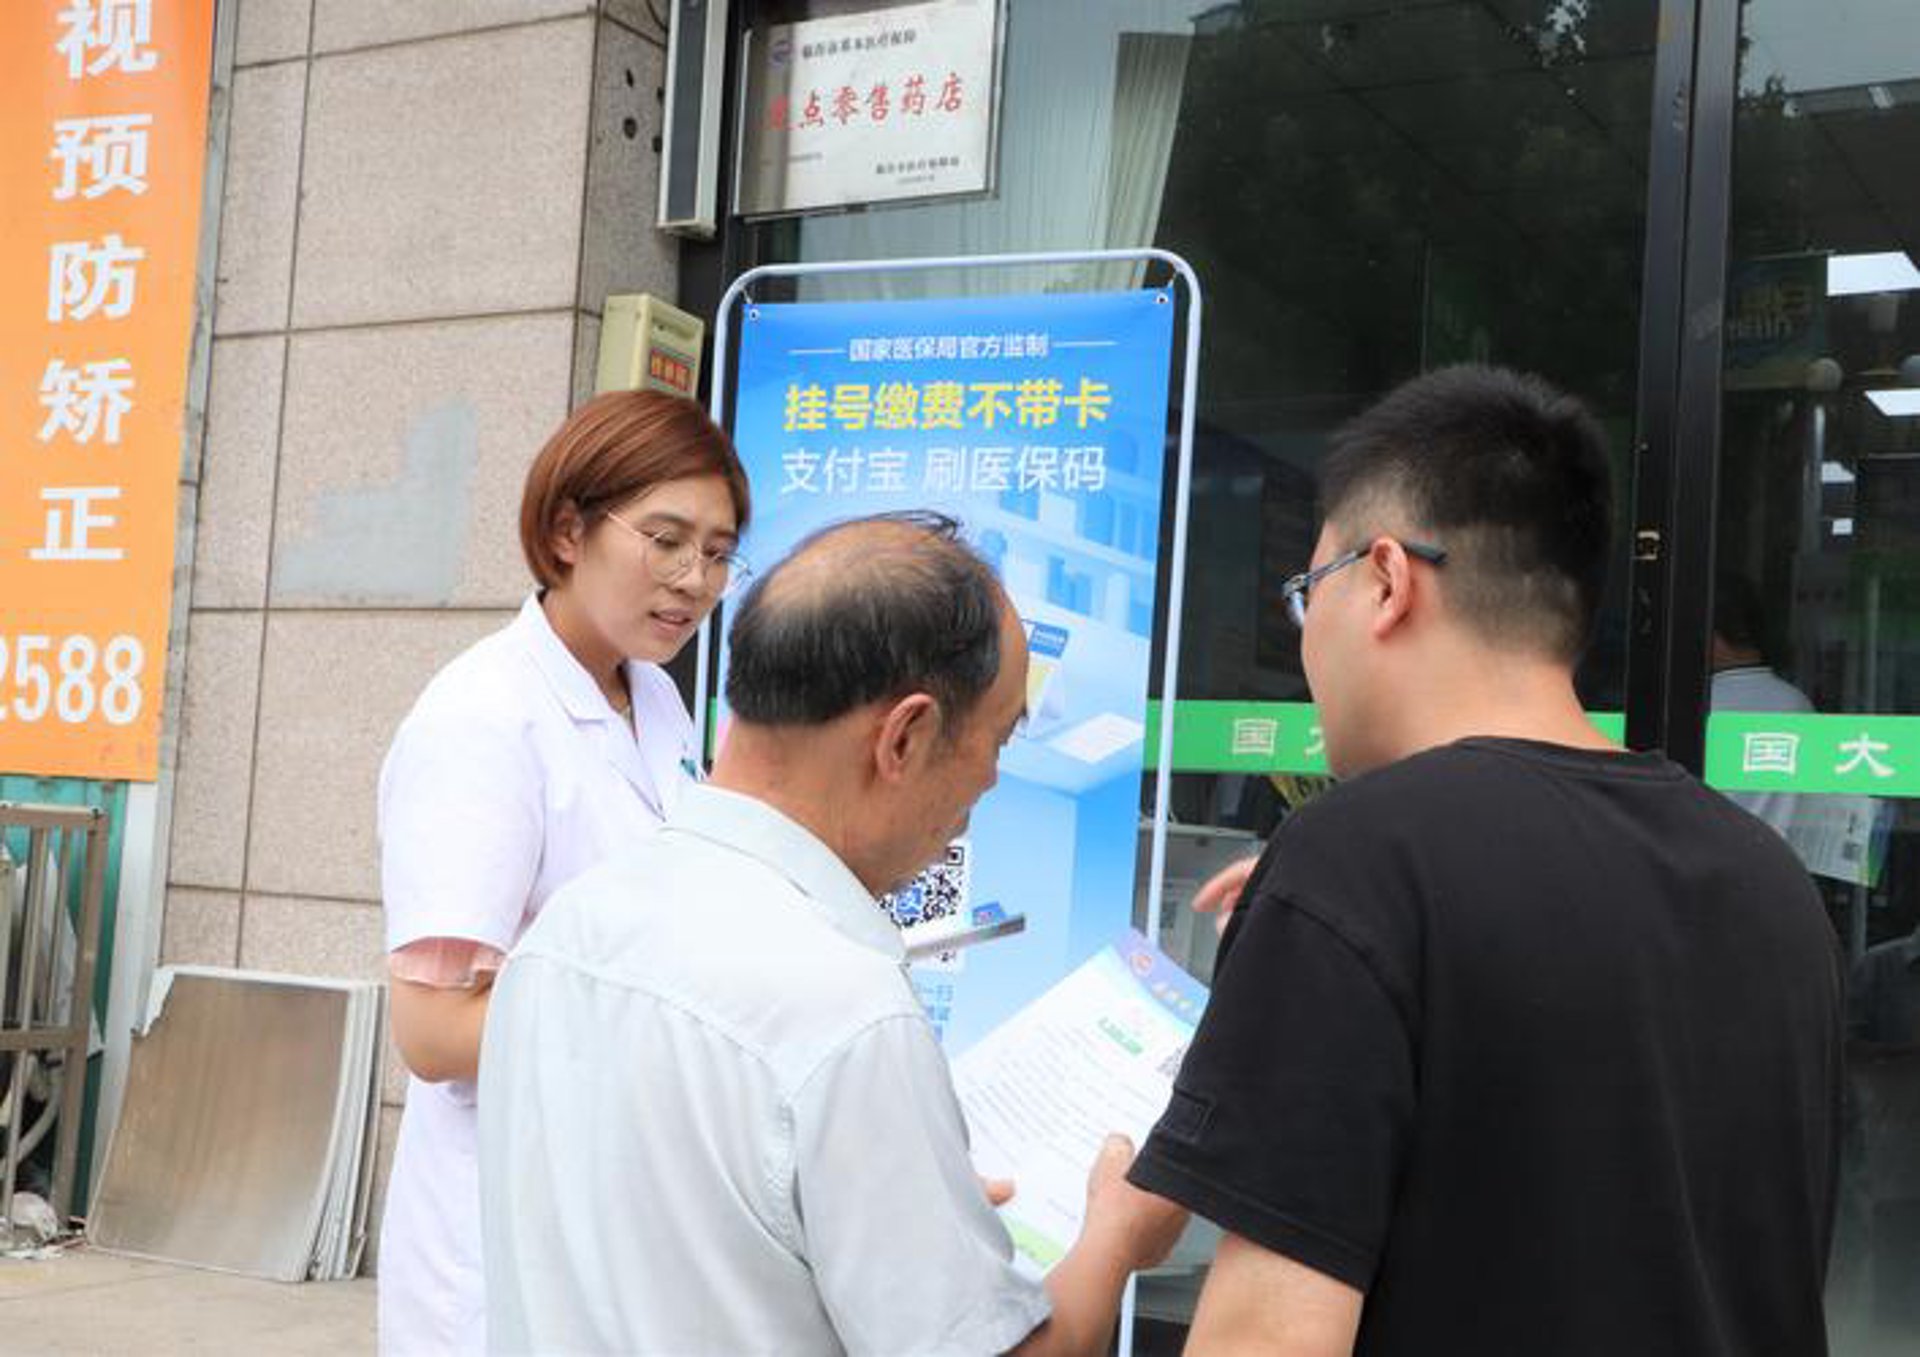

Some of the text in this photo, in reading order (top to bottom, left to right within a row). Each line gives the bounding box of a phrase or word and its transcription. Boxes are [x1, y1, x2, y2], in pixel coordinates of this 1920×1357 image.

[30, 0, 159, 561] 视预防矫正
[849, 333, 1050, 362] 国家医保局官方监制
[783, 376, 1113, 432] 挂号缴费不带卡
[780, 444, 1108, 494] 支付宝 刷医保码
[0, 633, 144, 726] 588
[1741, 730, 1898, 777] 国大
